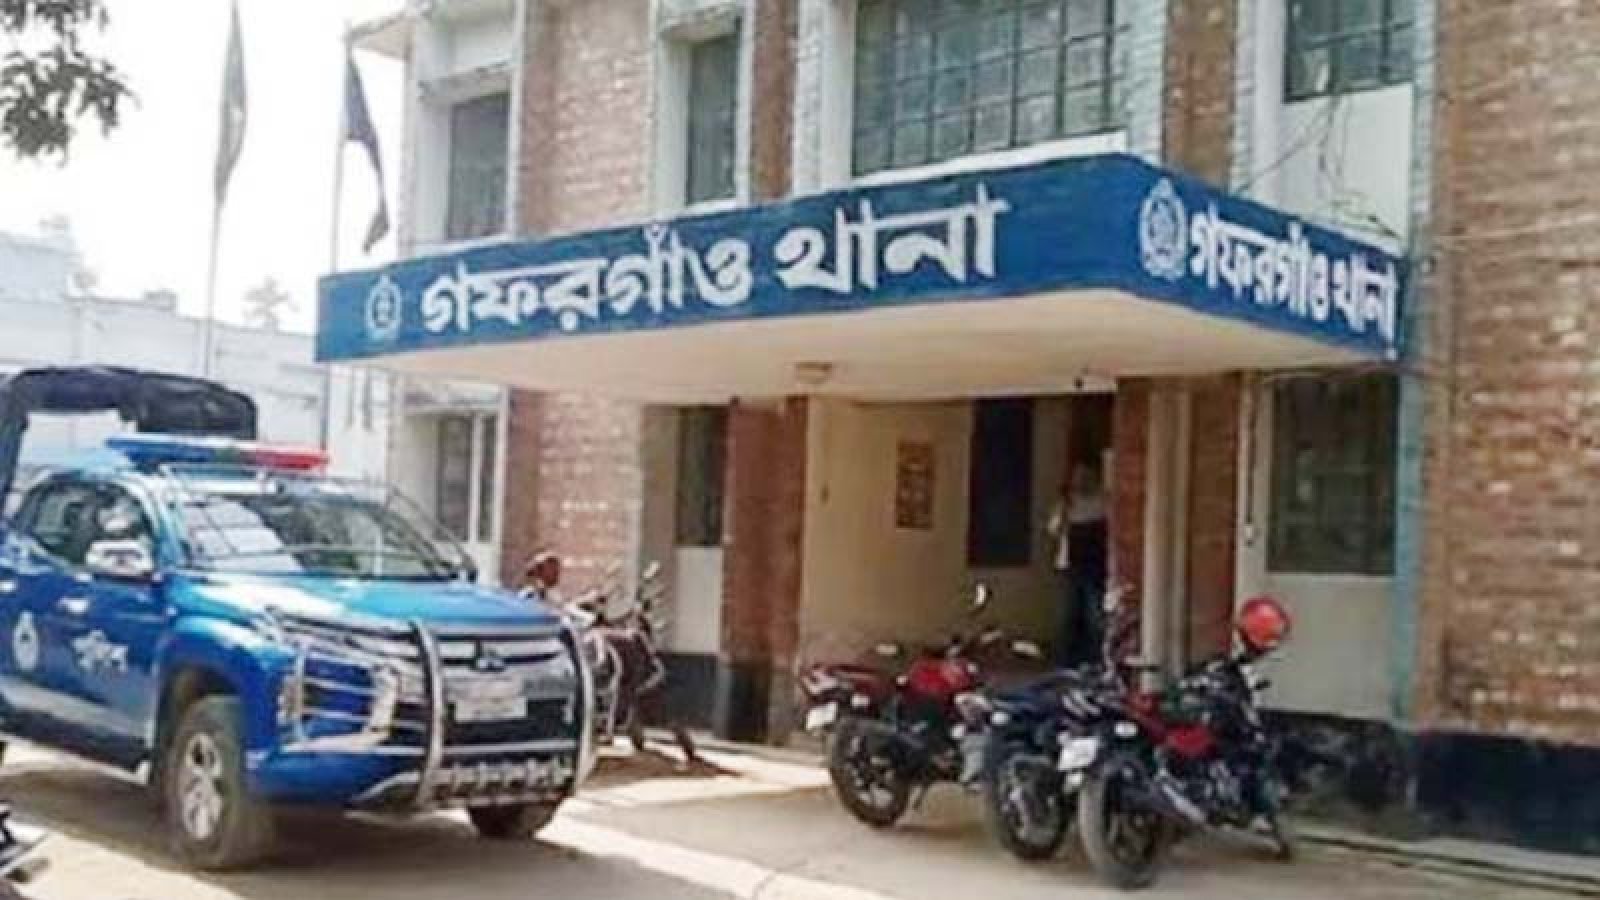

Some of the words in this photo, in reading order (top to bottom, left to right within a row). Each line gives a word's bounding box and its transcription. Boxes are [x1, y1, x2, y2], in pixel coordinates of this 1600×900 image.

[421, 224, 753, 332] গফরগাঁও
[774, 182, 1012, 293] থানা
[1332, 252, 1398, 343] থানা
